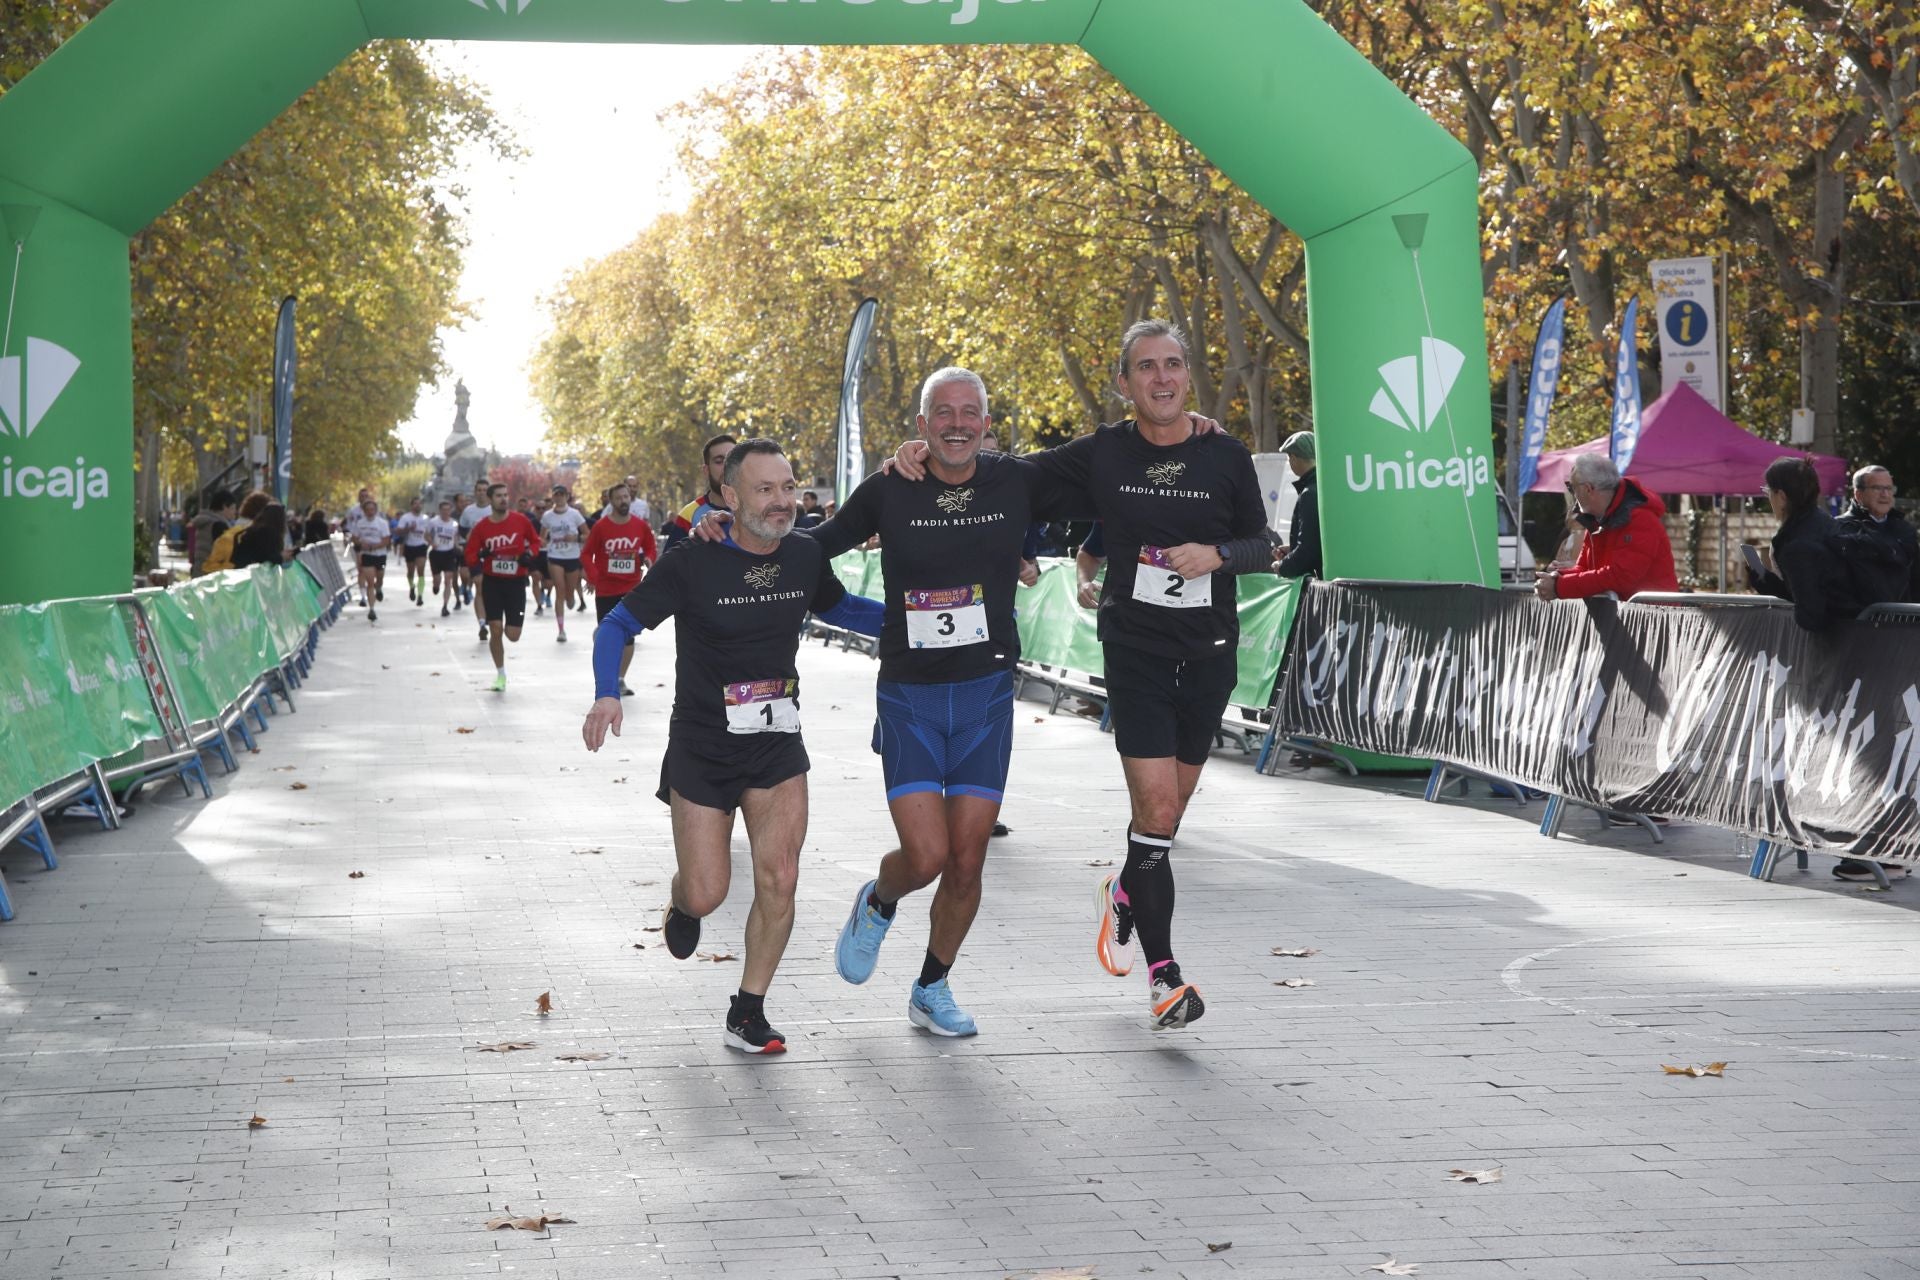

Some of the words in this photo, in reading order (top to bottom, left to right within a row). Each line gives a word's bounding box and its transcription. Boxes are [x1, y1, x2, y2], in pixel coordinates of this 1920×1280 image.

[1659, 267, 1685, 276] Oficina
[1687, 266, 1696, 275] de
[1680, 304, 1692, 341] i
[1526, 338, 1560, 457] IVECO
[1346, 446, 1489, 497] Unicaja
[1119, 485, 1155, 495] ABADIA
[1159, 488, 1210, 499] RETUERTA
[910, 519, 948, 527] ABADIA
[953, 512, 1005, 526] RETUERTA
[605, 536, 639, 552] gmv
[495, 562, 515, 570] 401
[612, 561, 631, 569] 400
[1164, 574, 1185, 597] 2
[717, 596, 755, 605] ABADIA
[760, 590, 804, 602] RETUERTA
[936, 613, 956, 636] 3
[760, 703, 773, 725] 1
